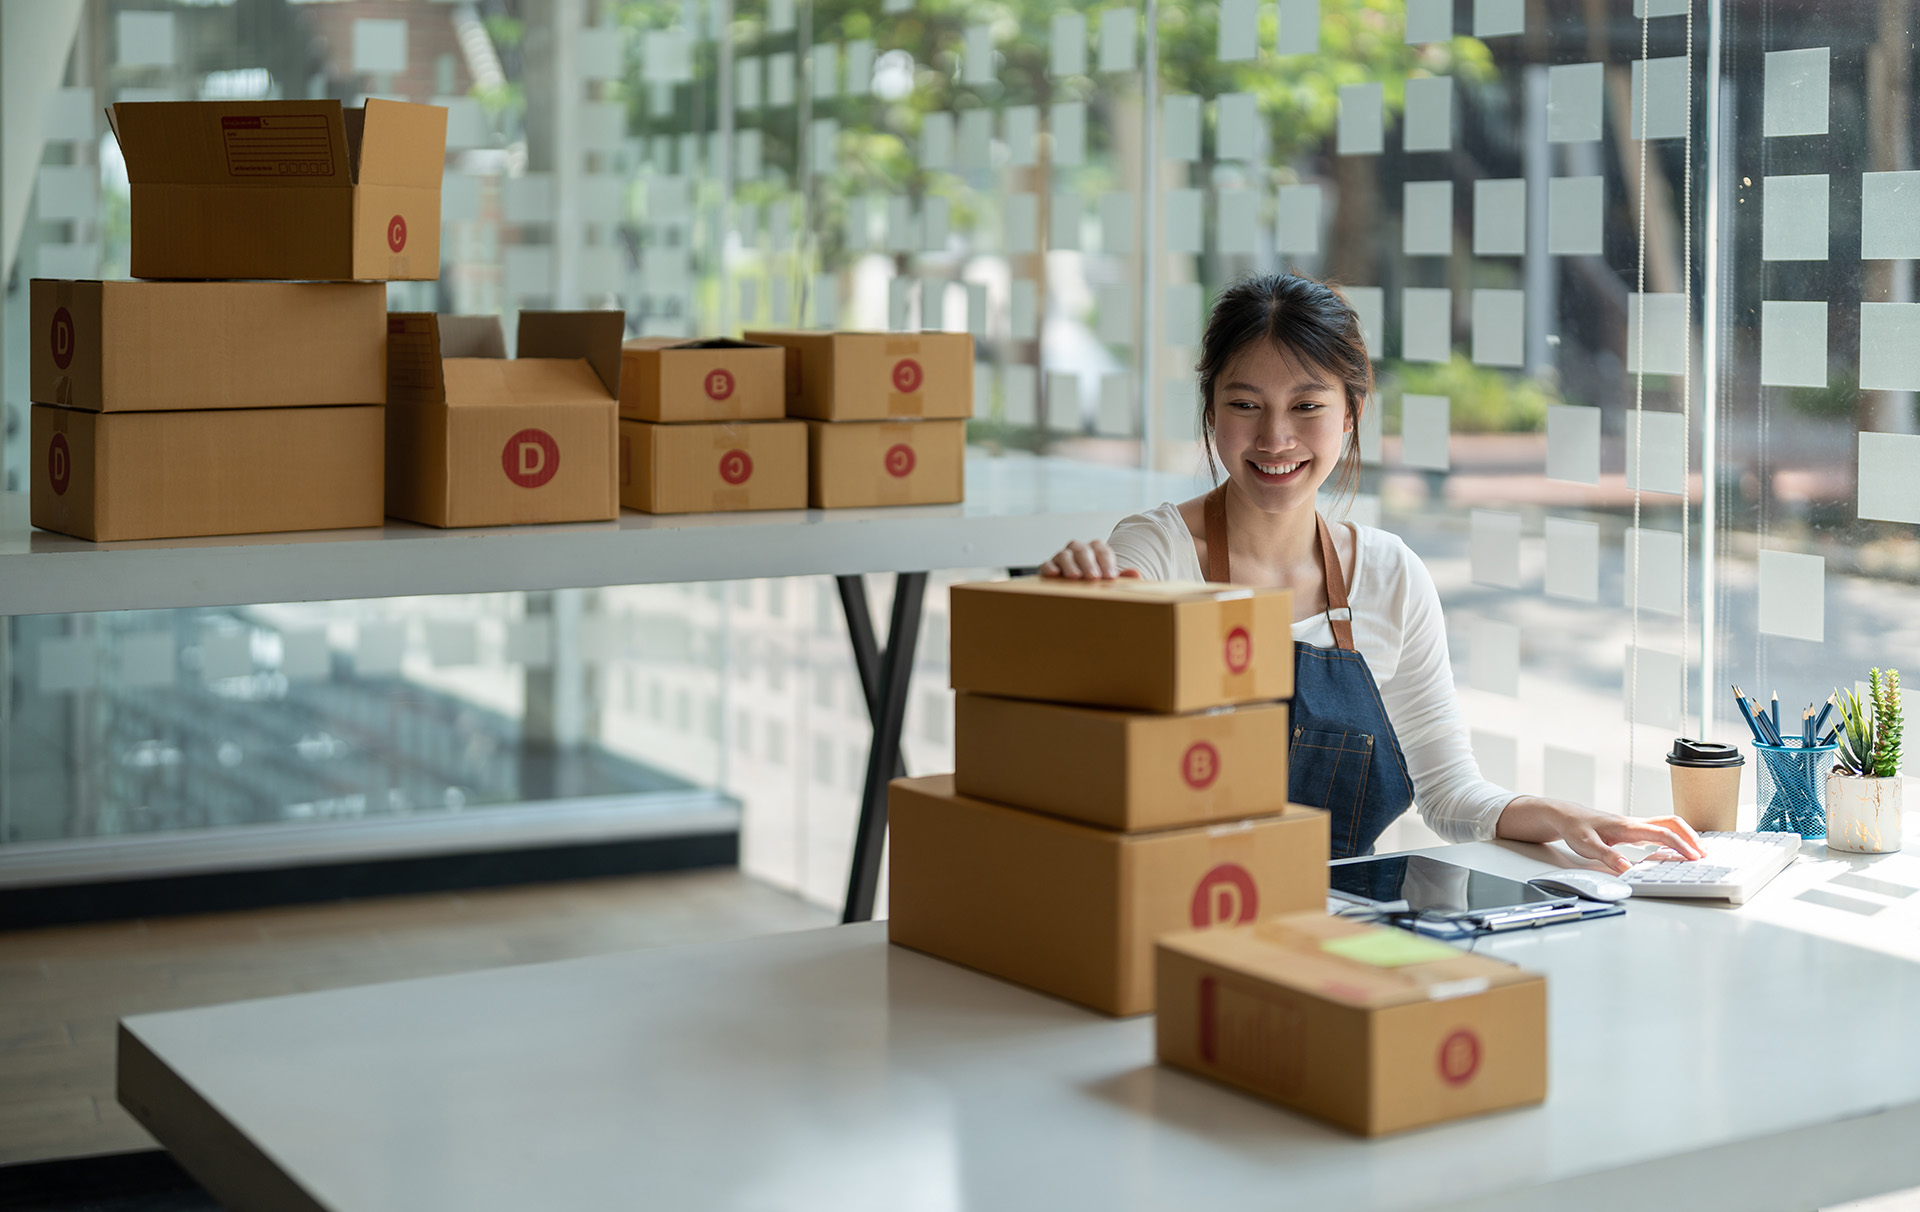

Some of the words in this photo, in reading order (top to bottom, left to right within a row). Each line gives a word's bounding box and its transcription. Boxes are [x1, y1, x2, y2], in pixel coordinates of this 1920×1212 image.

[393, 224, 402, 245] C
[57, 321, 69, 355] D
[712, 375, 728, 393] B
[900, 366, 915, 385] C
[54, 447, 65, 480] D
[519, 442, 545, 475] D
[729, 457, 744, 478] C
[892, 451, 908, 471] C
[1190, 750, 1210, 780] B
[1210, 884, 1242, 926] D
